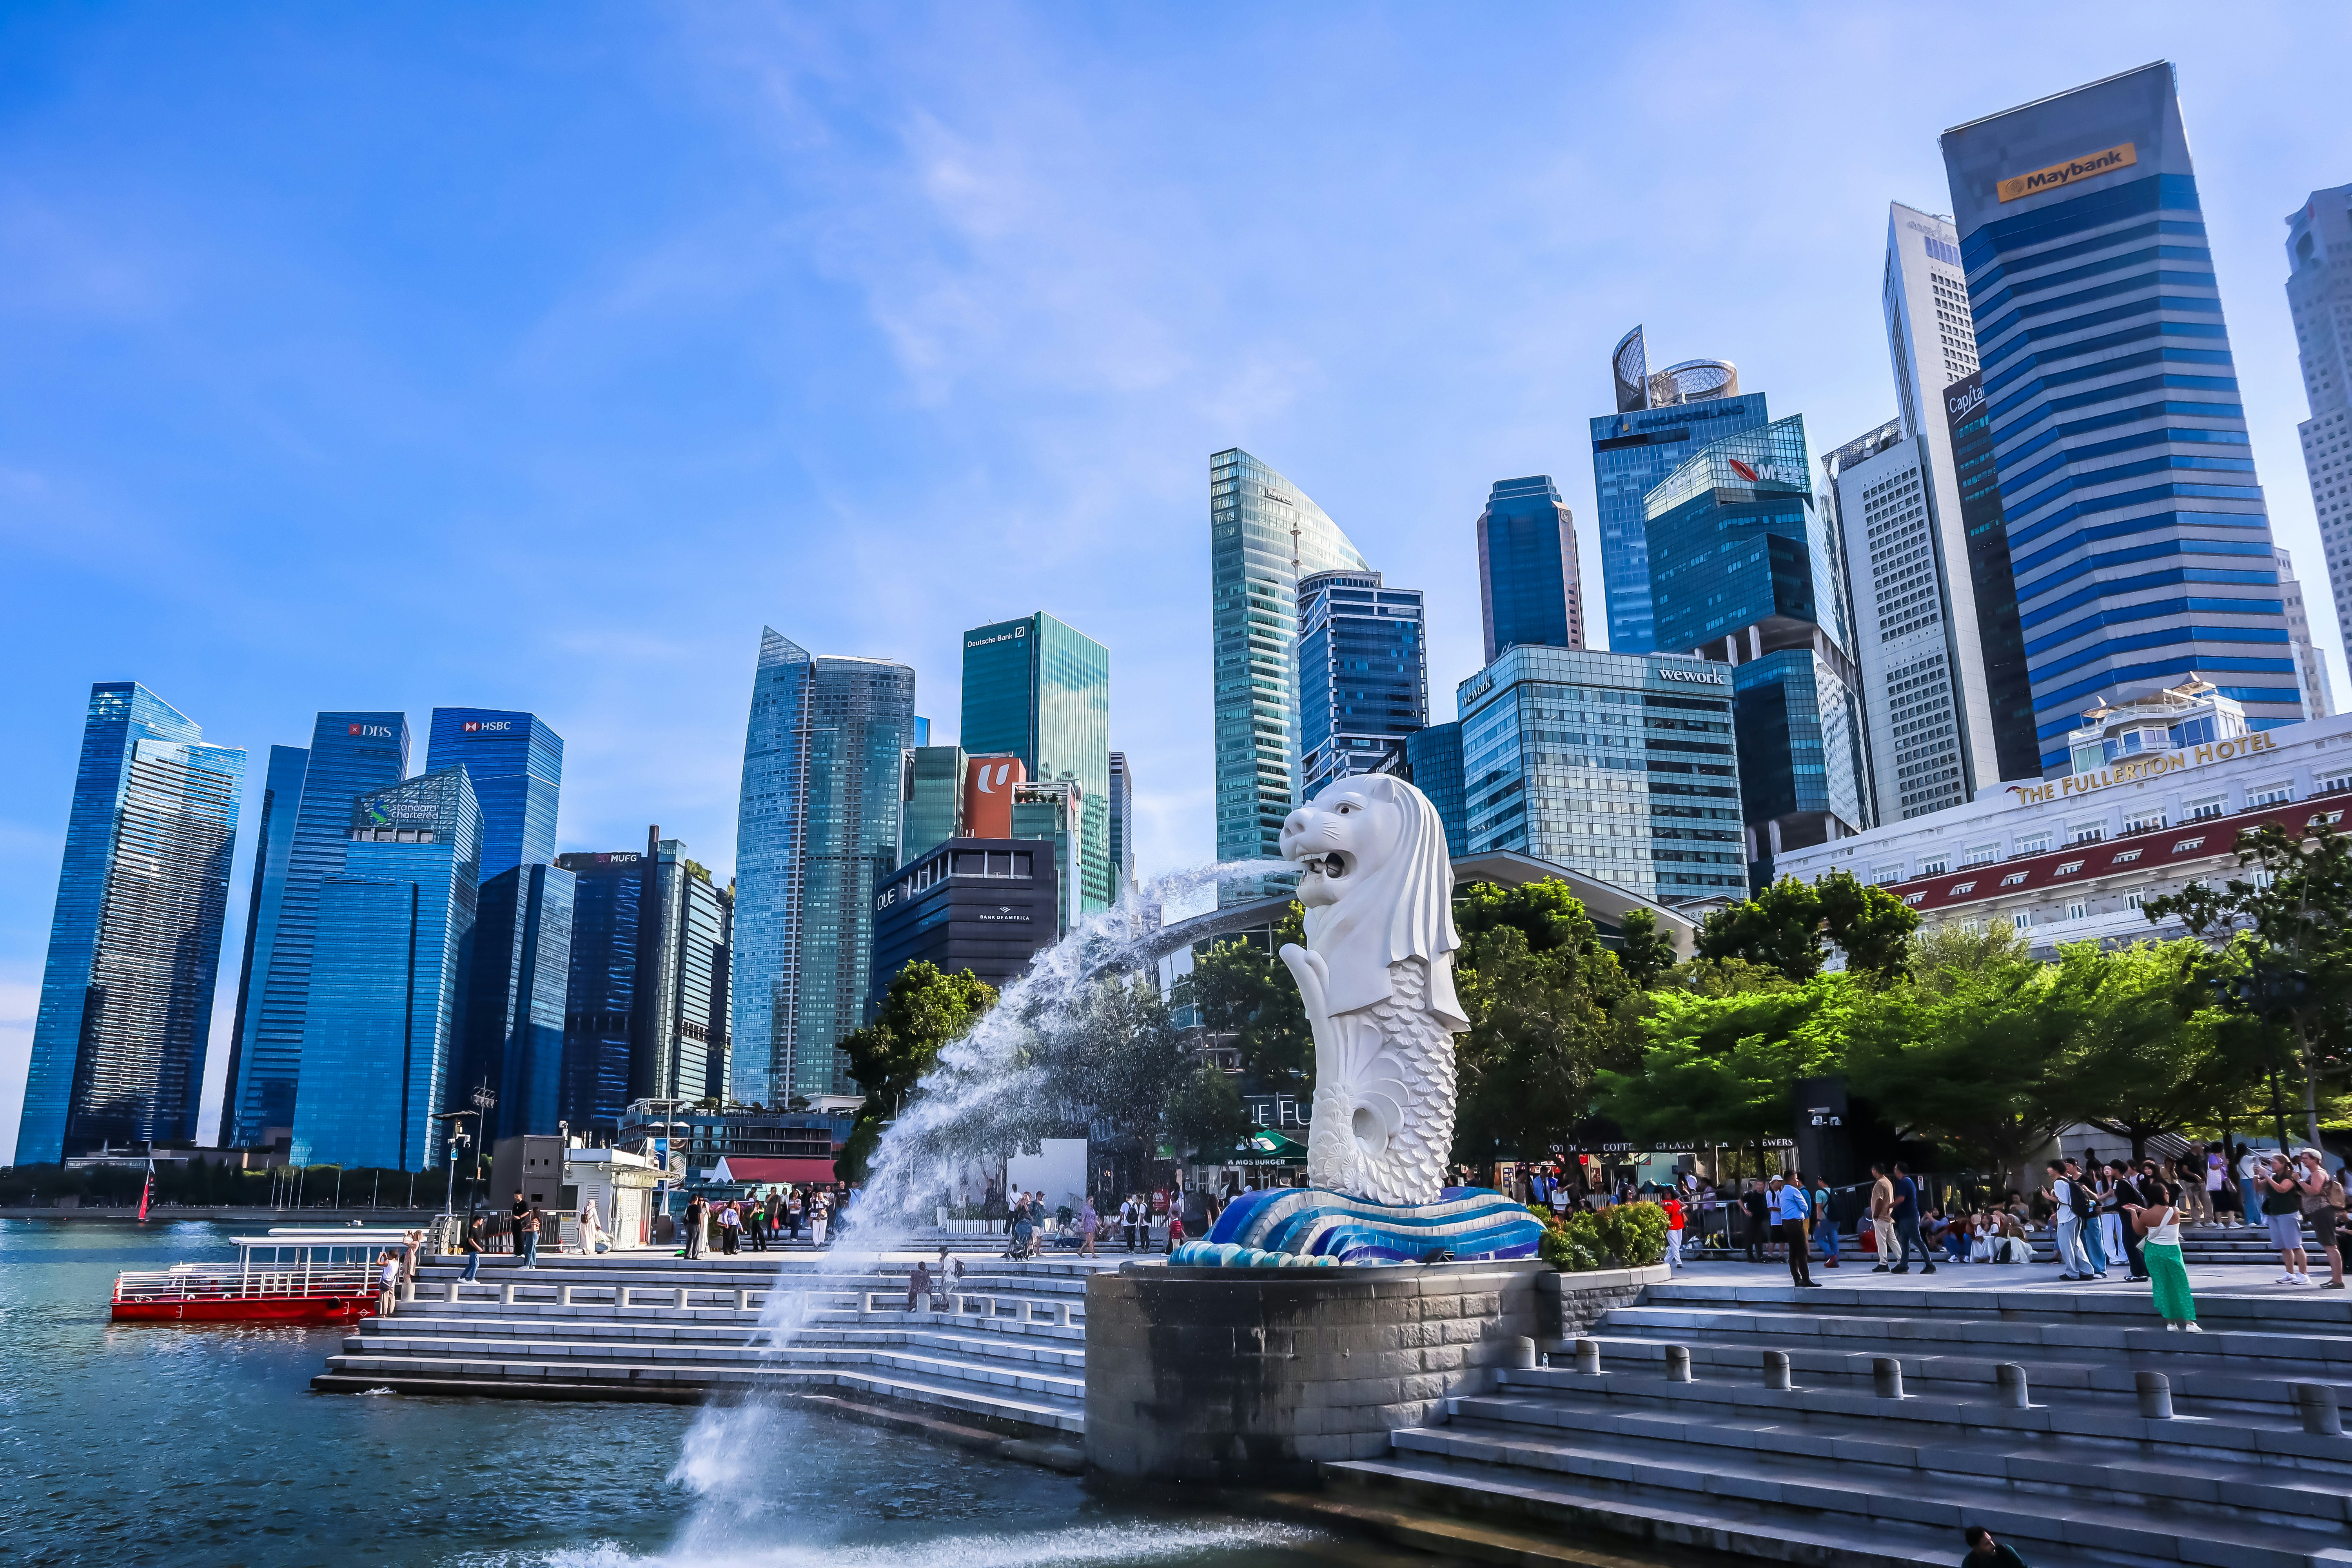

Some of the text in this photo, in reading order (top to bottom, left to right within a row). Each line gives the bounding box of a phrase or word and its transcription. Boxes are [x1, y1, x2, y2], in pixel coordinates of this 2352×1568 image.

[2027, 151, 2123, 189] Maybank
[1758, 464, 1804, 481] MYP
[1665, 468, 1700, 499] MYP
[1267, 488, 1292, 503] Keppel
[967, 633, 1013, 648] Deutsche Bank
[1658, 668, 1725, 684] wework
[1461, 673, 1491, 707] wework
[362, 724, 392, 737] DBS
[481, 721, 511, 731] HSBC
[2016, 732, 2277, 805] THE FULLERTON HOTEL
[392, 803, 437, 812] standard
[877, 888, 895, 911] OUE
[1750, 1139, 1793, 1147] SEWERS
